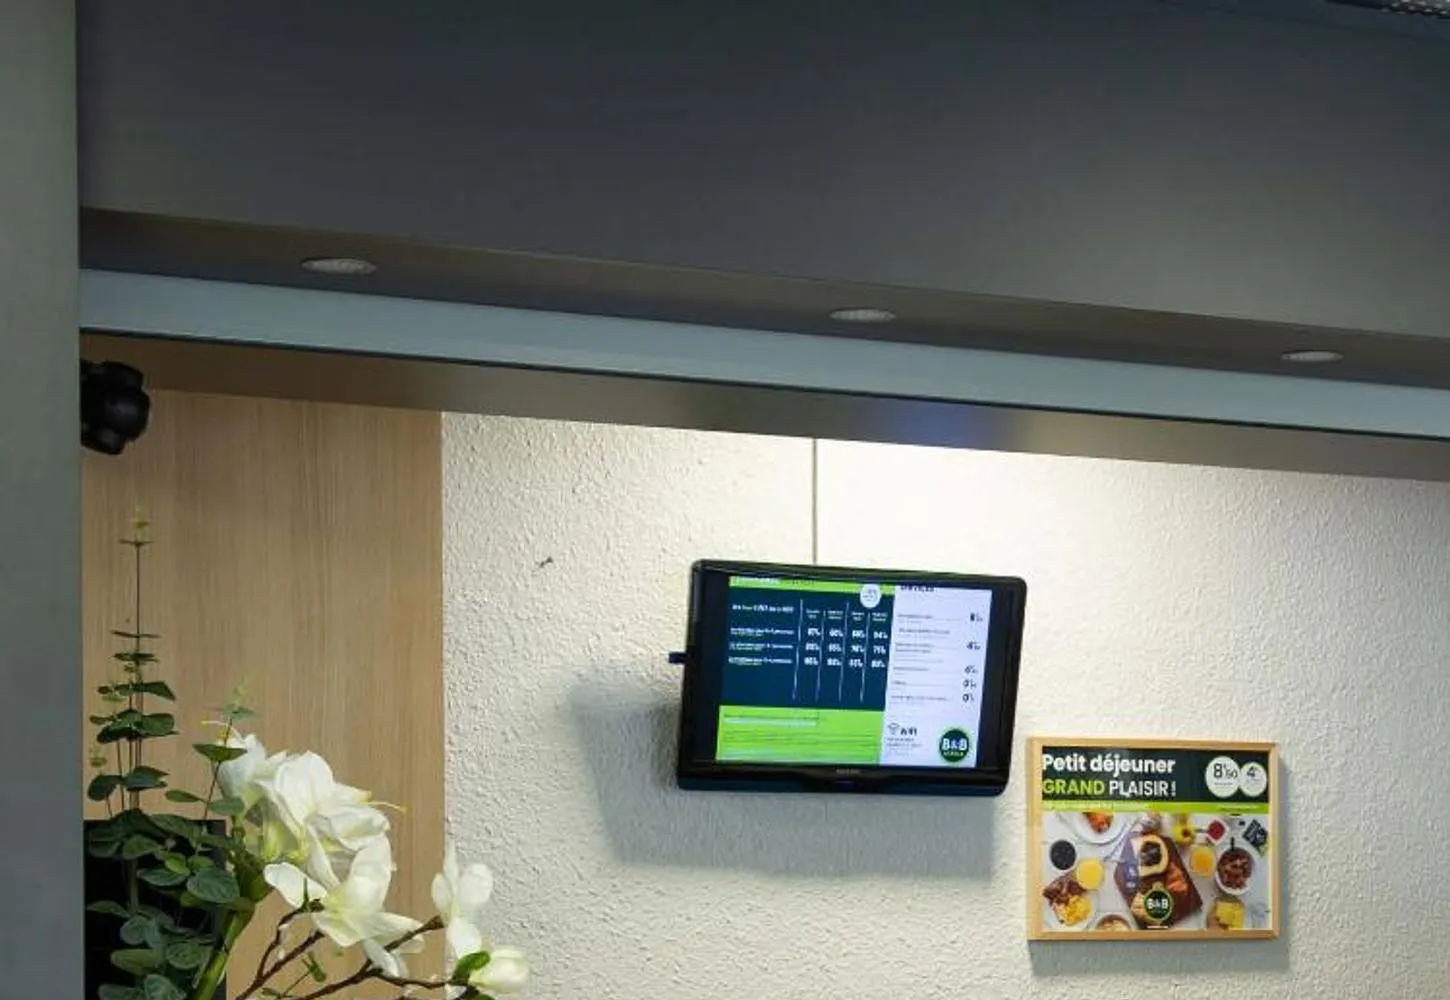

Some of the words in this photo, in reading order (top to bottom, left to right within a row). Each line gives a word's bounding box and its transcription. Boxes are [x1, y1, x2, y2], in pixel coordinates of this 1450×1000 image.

[1042, 753, 1086, 772] Petit
[1089, 753, 1176, 778] déjeuner
[1042, 779, 1105, 795] GRAND
